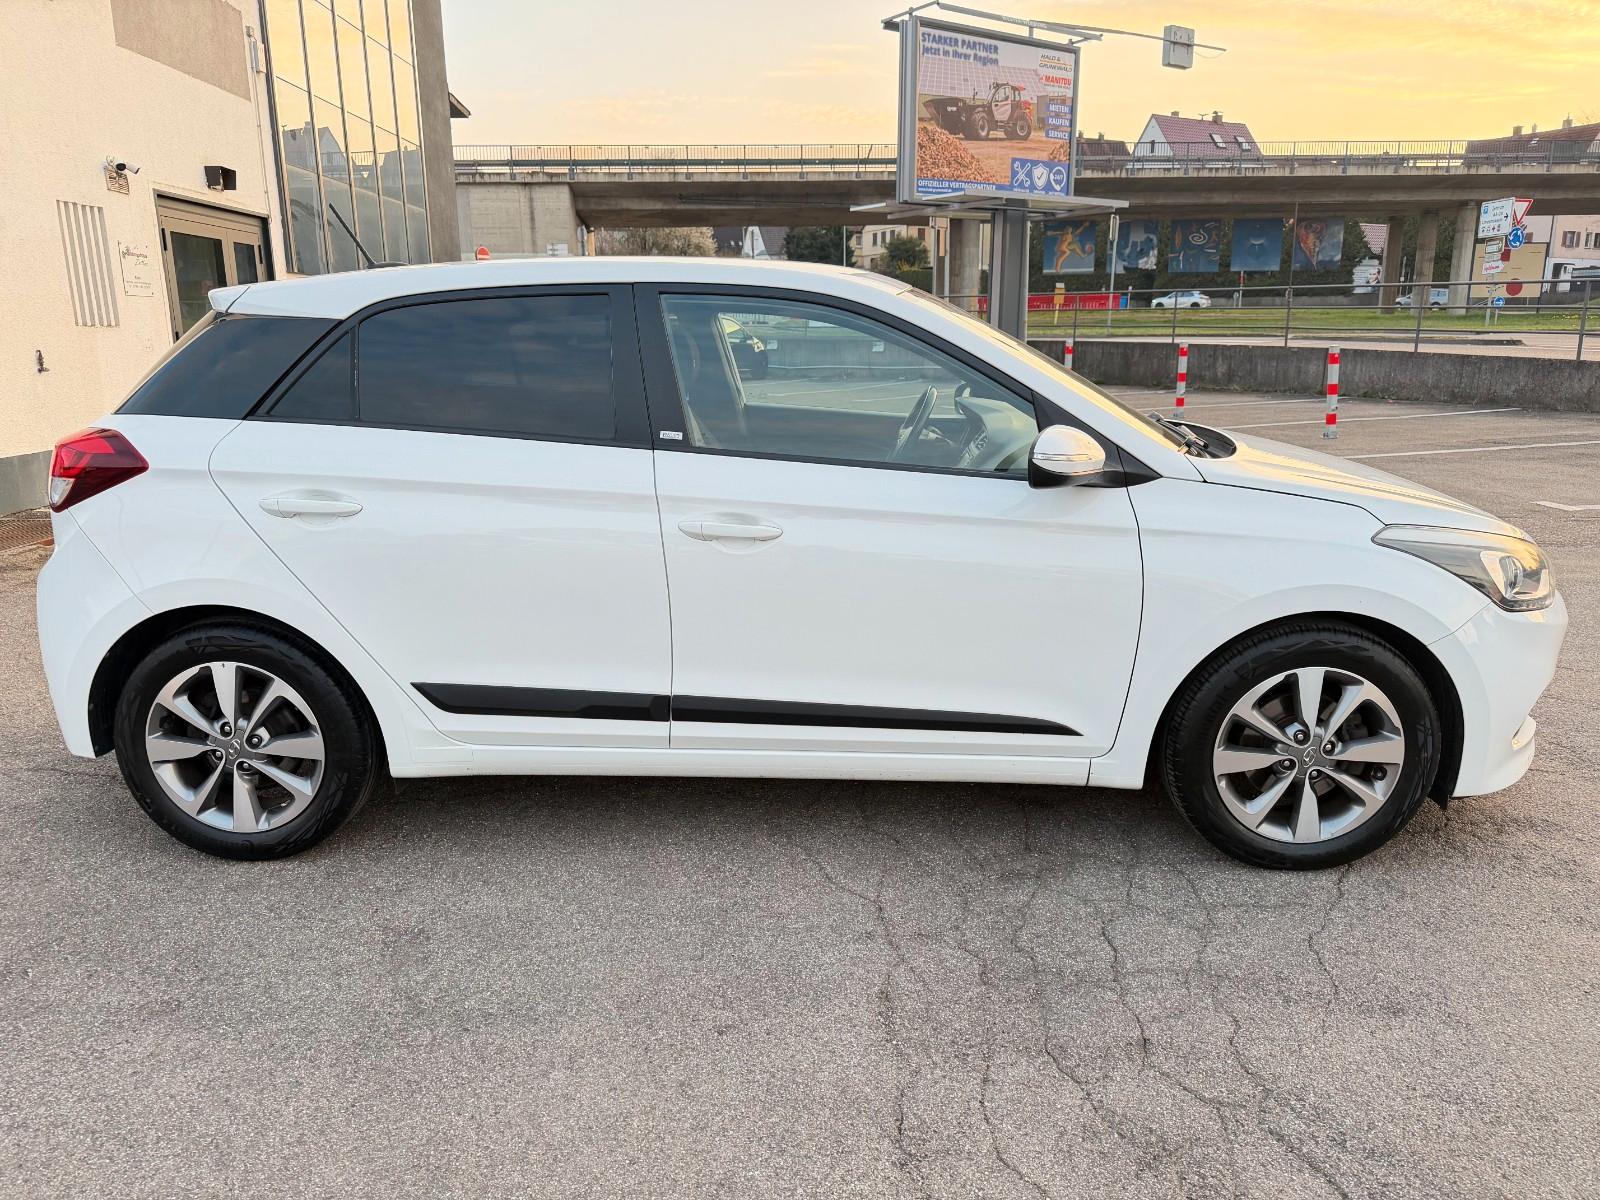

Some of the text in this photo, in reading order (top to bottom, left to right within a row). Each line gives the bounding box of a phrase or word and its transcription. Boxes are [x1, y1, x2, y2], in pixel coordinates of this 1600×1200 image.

[921, 32, 999, 55] STARKER PARTNER
[942, 47, 950, 58] in
[973, 52, 999, 65] Region
[1044, 75, 1072, 86] MANITOU
[1049, 103, 1069, 113] MIETEN
[1048, 117, 1069, 127] KAUFEN
[1048, 130, 1069, 139] SERVICE
[918, 179, 949, 188] OFFIZIELLER
